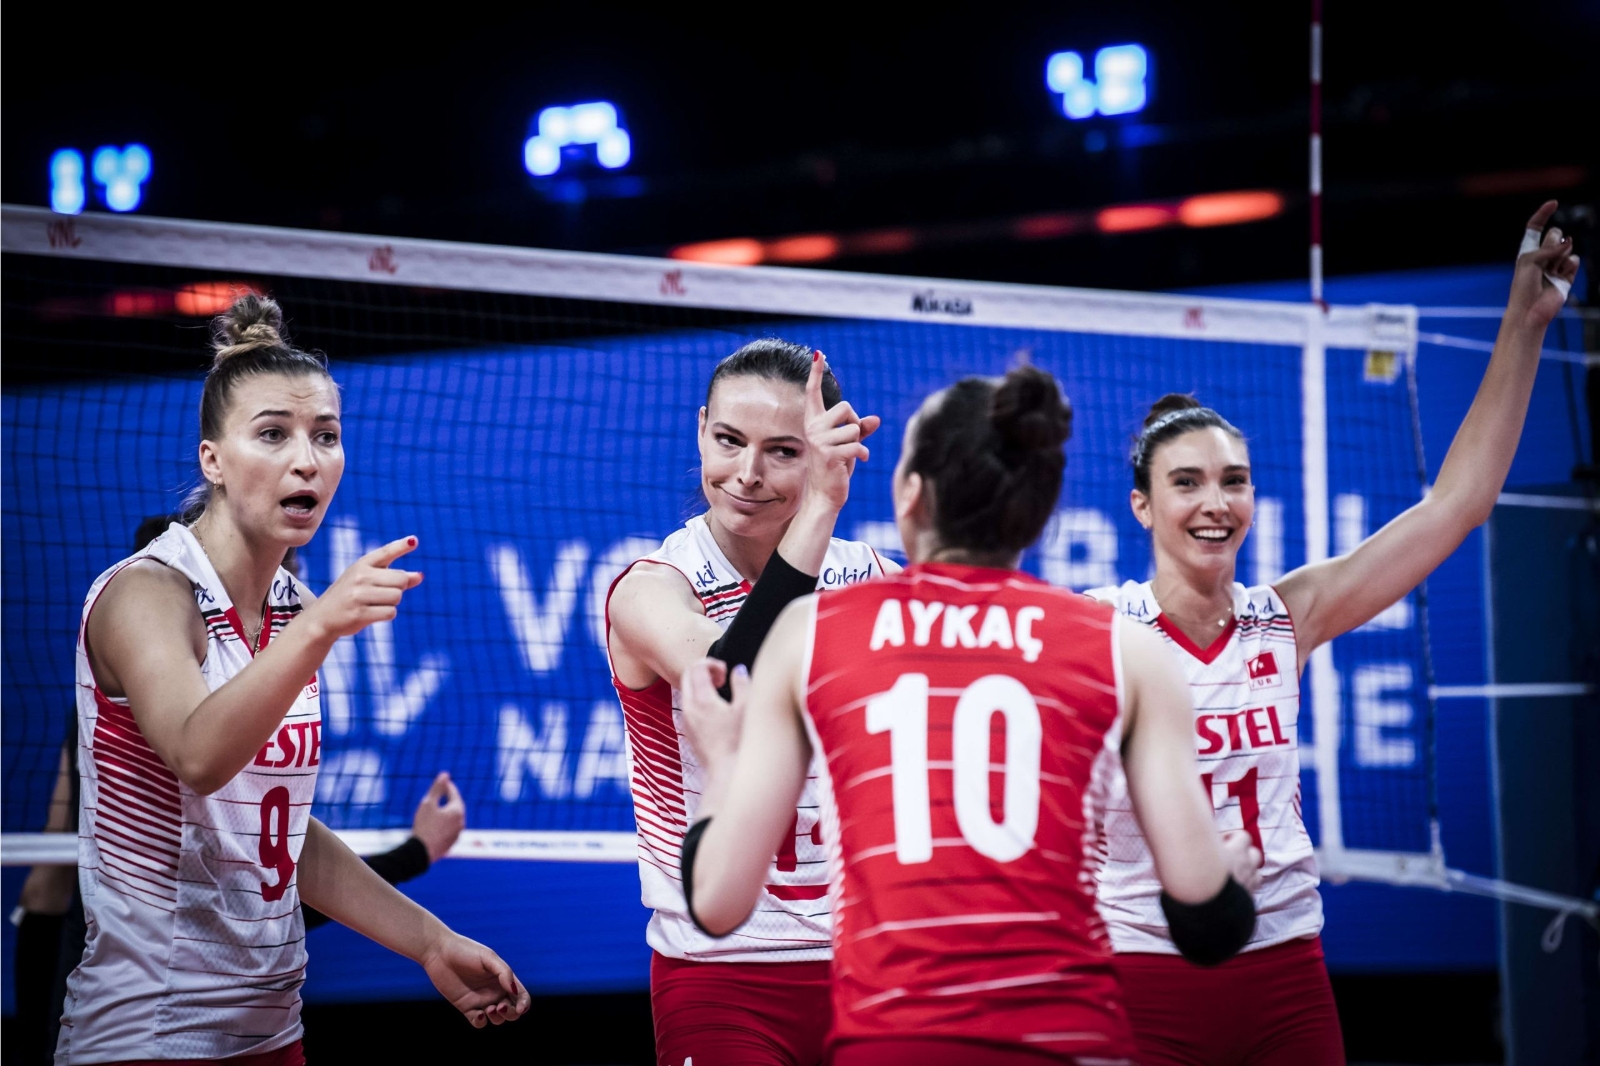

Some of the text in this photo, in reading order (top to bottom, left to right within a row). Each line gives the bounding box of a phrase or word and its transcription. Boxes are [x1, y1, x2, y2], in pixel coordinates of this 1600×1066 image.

[823, 563, 873, 586] Orkid
[869, 598, 1045, 662] AYKAÇ
[865, 672, 1043, 864] 10
[258, 785, 296, 903] 9
